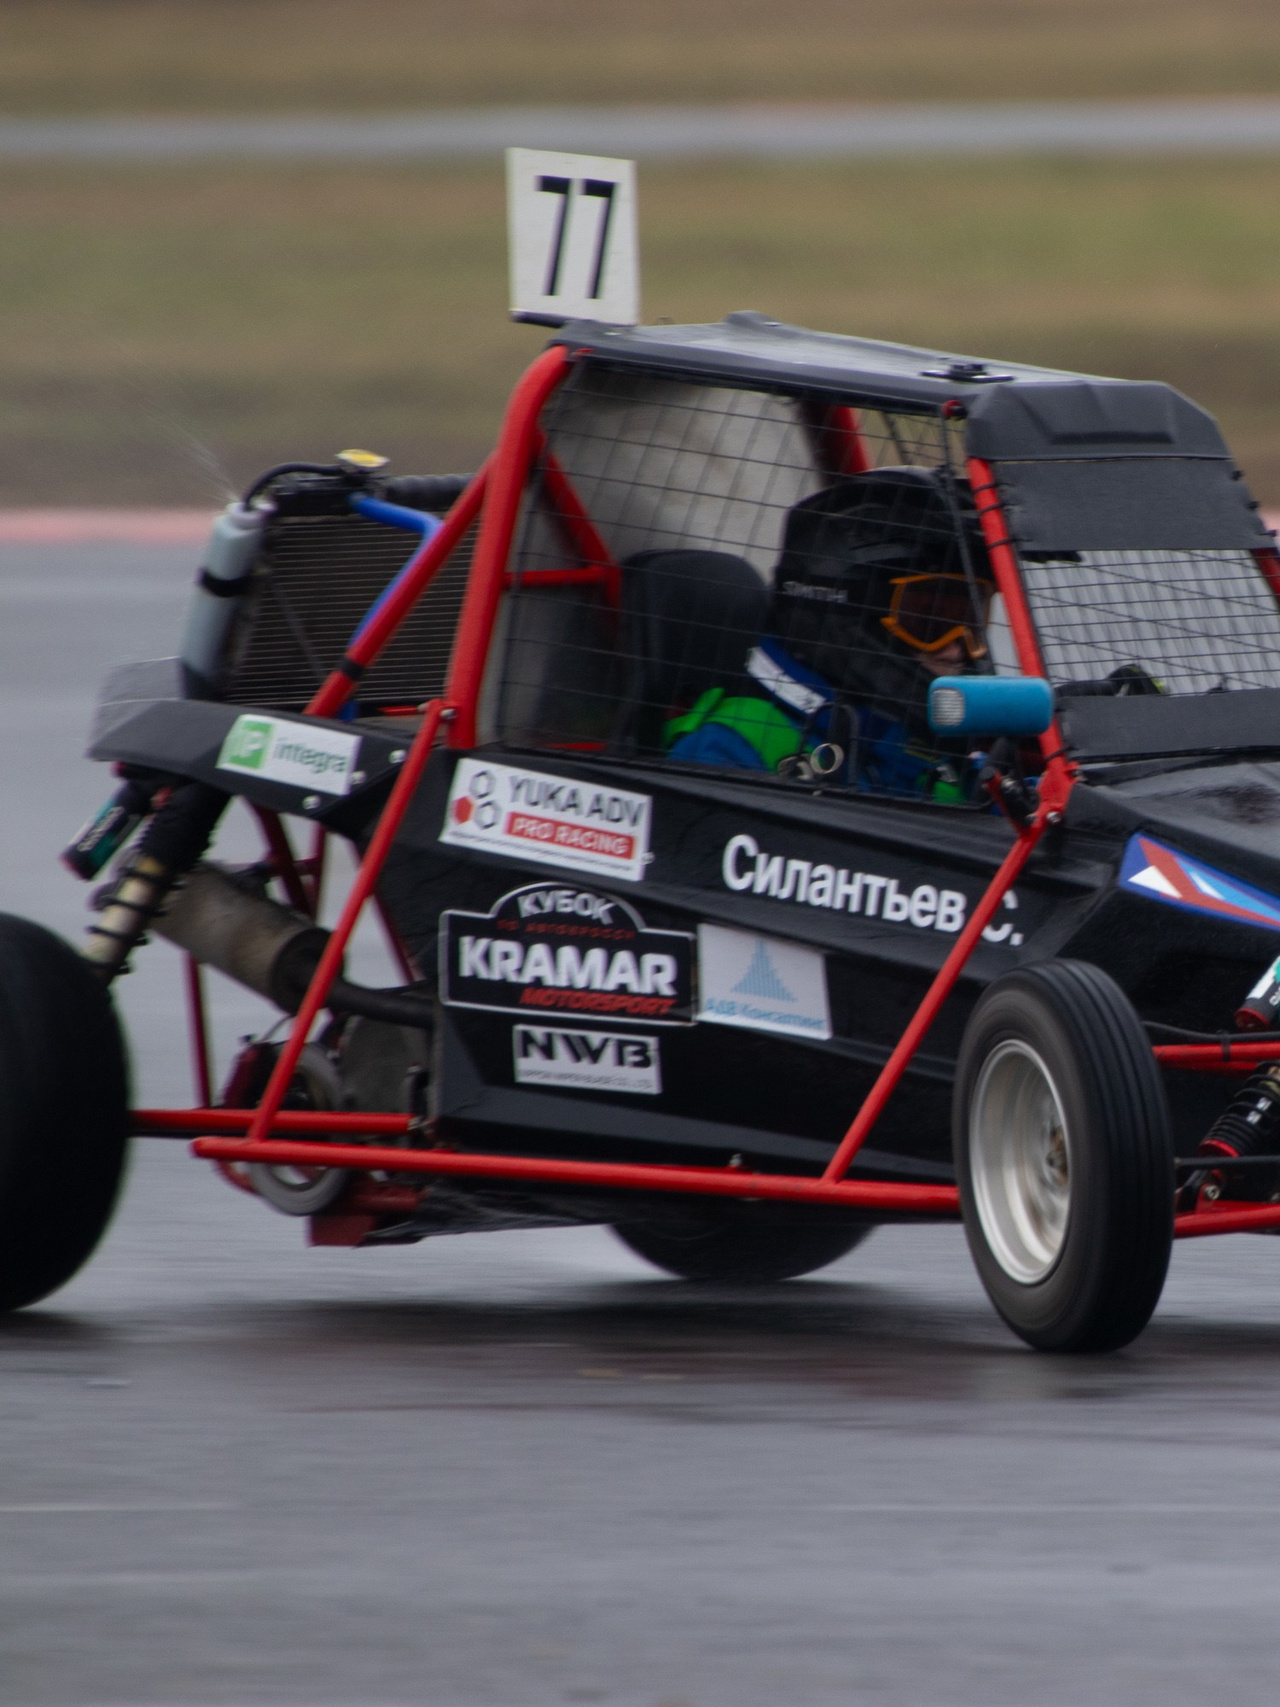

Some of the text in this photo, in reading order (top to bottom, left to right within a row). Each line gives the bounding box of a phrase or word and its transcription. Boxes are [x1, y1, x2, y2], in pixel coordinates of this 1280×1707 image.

[534, 174, 619, 300] 77
[508, 774, 644, 827] YUKA ADV
[512, 817, 555, 840] PRO
[555, 825, 629, 855] RACING
[722, 834, 967, 933] Силантьев
[517, 889, 617, 926] КУБОК
[458, 935, 679, 997] KRAMAR
[519, 986, 678, 1017] MOTORSPORT
[515, 1029, 655, 1069] NWB
